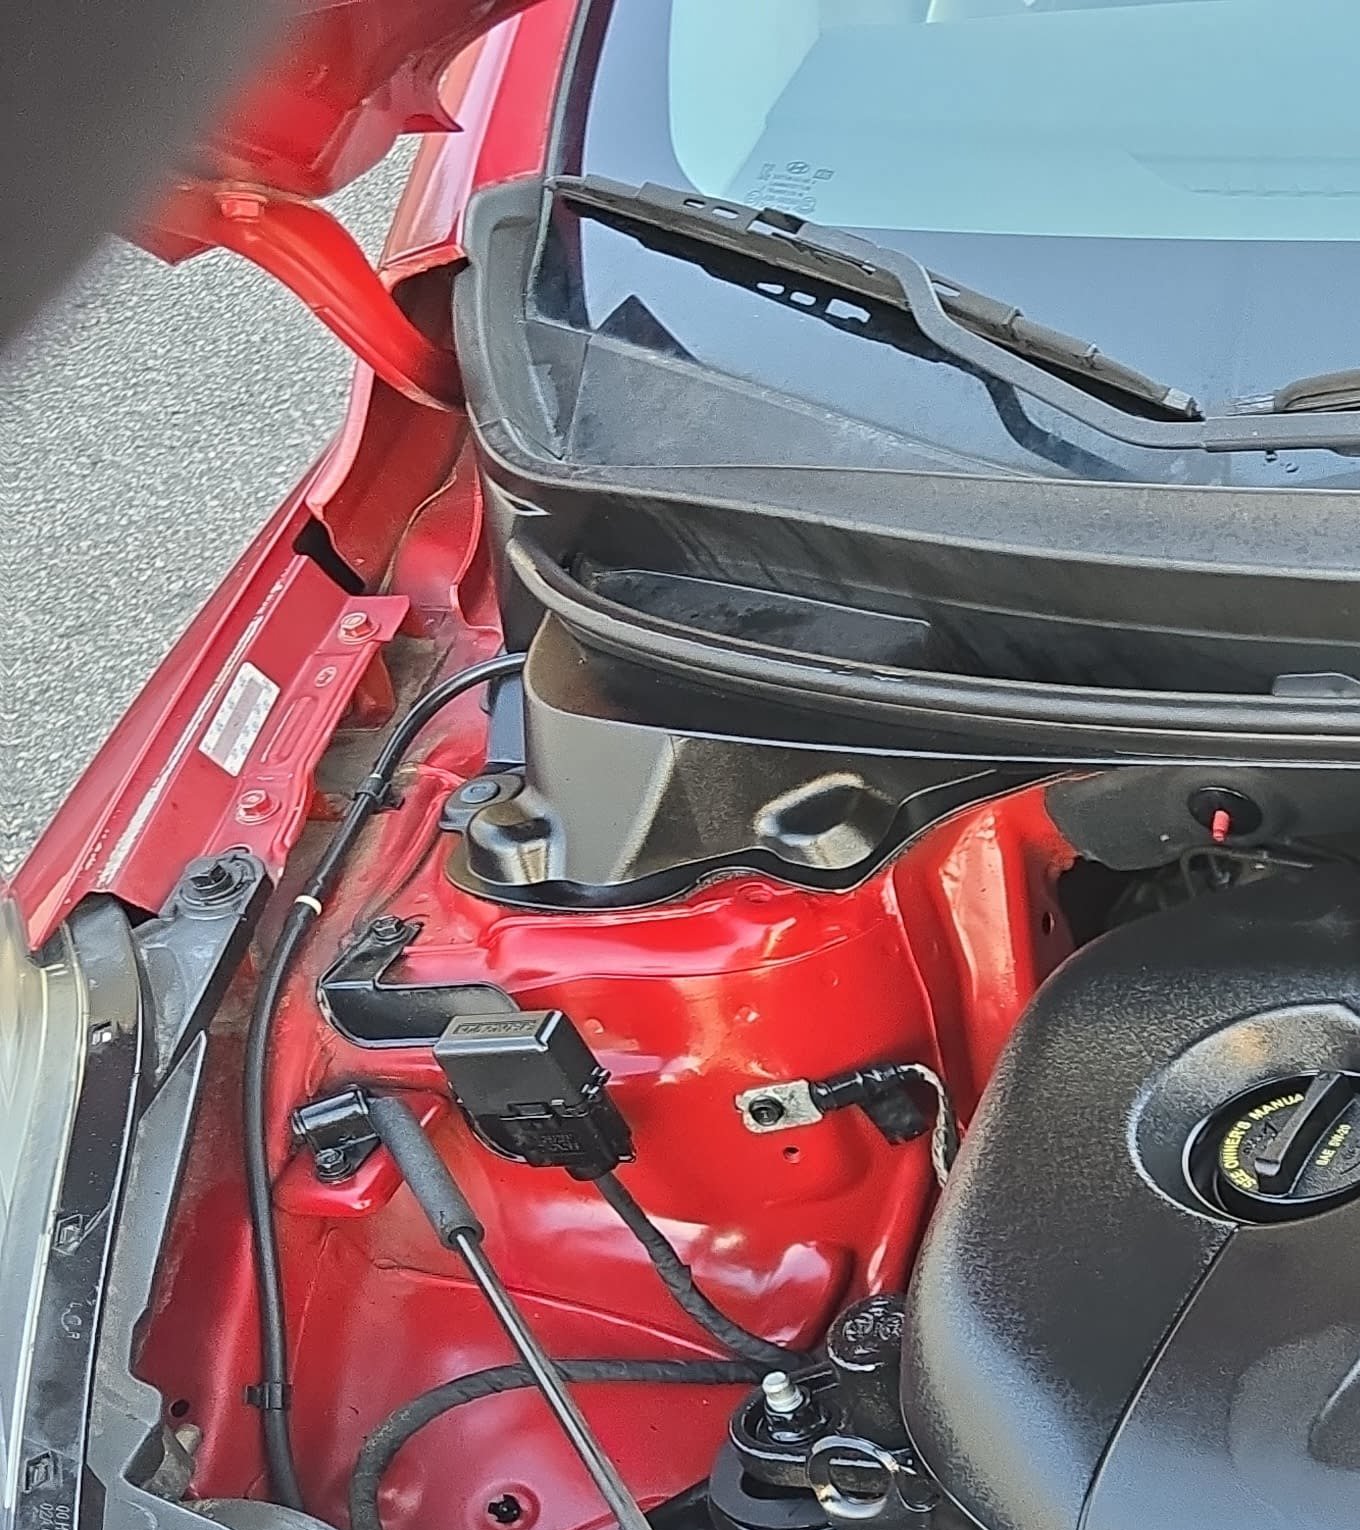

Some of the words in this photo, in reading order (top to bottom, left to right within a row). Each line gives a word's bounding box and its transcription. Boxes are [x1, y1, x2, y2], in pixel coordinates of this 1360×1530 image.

[1249, 1093, 1305, 1121] MANUA
[1222, 1120, 1252, 1169] OWNER'S
[1228, 1169, 1257, 1189] SEE
